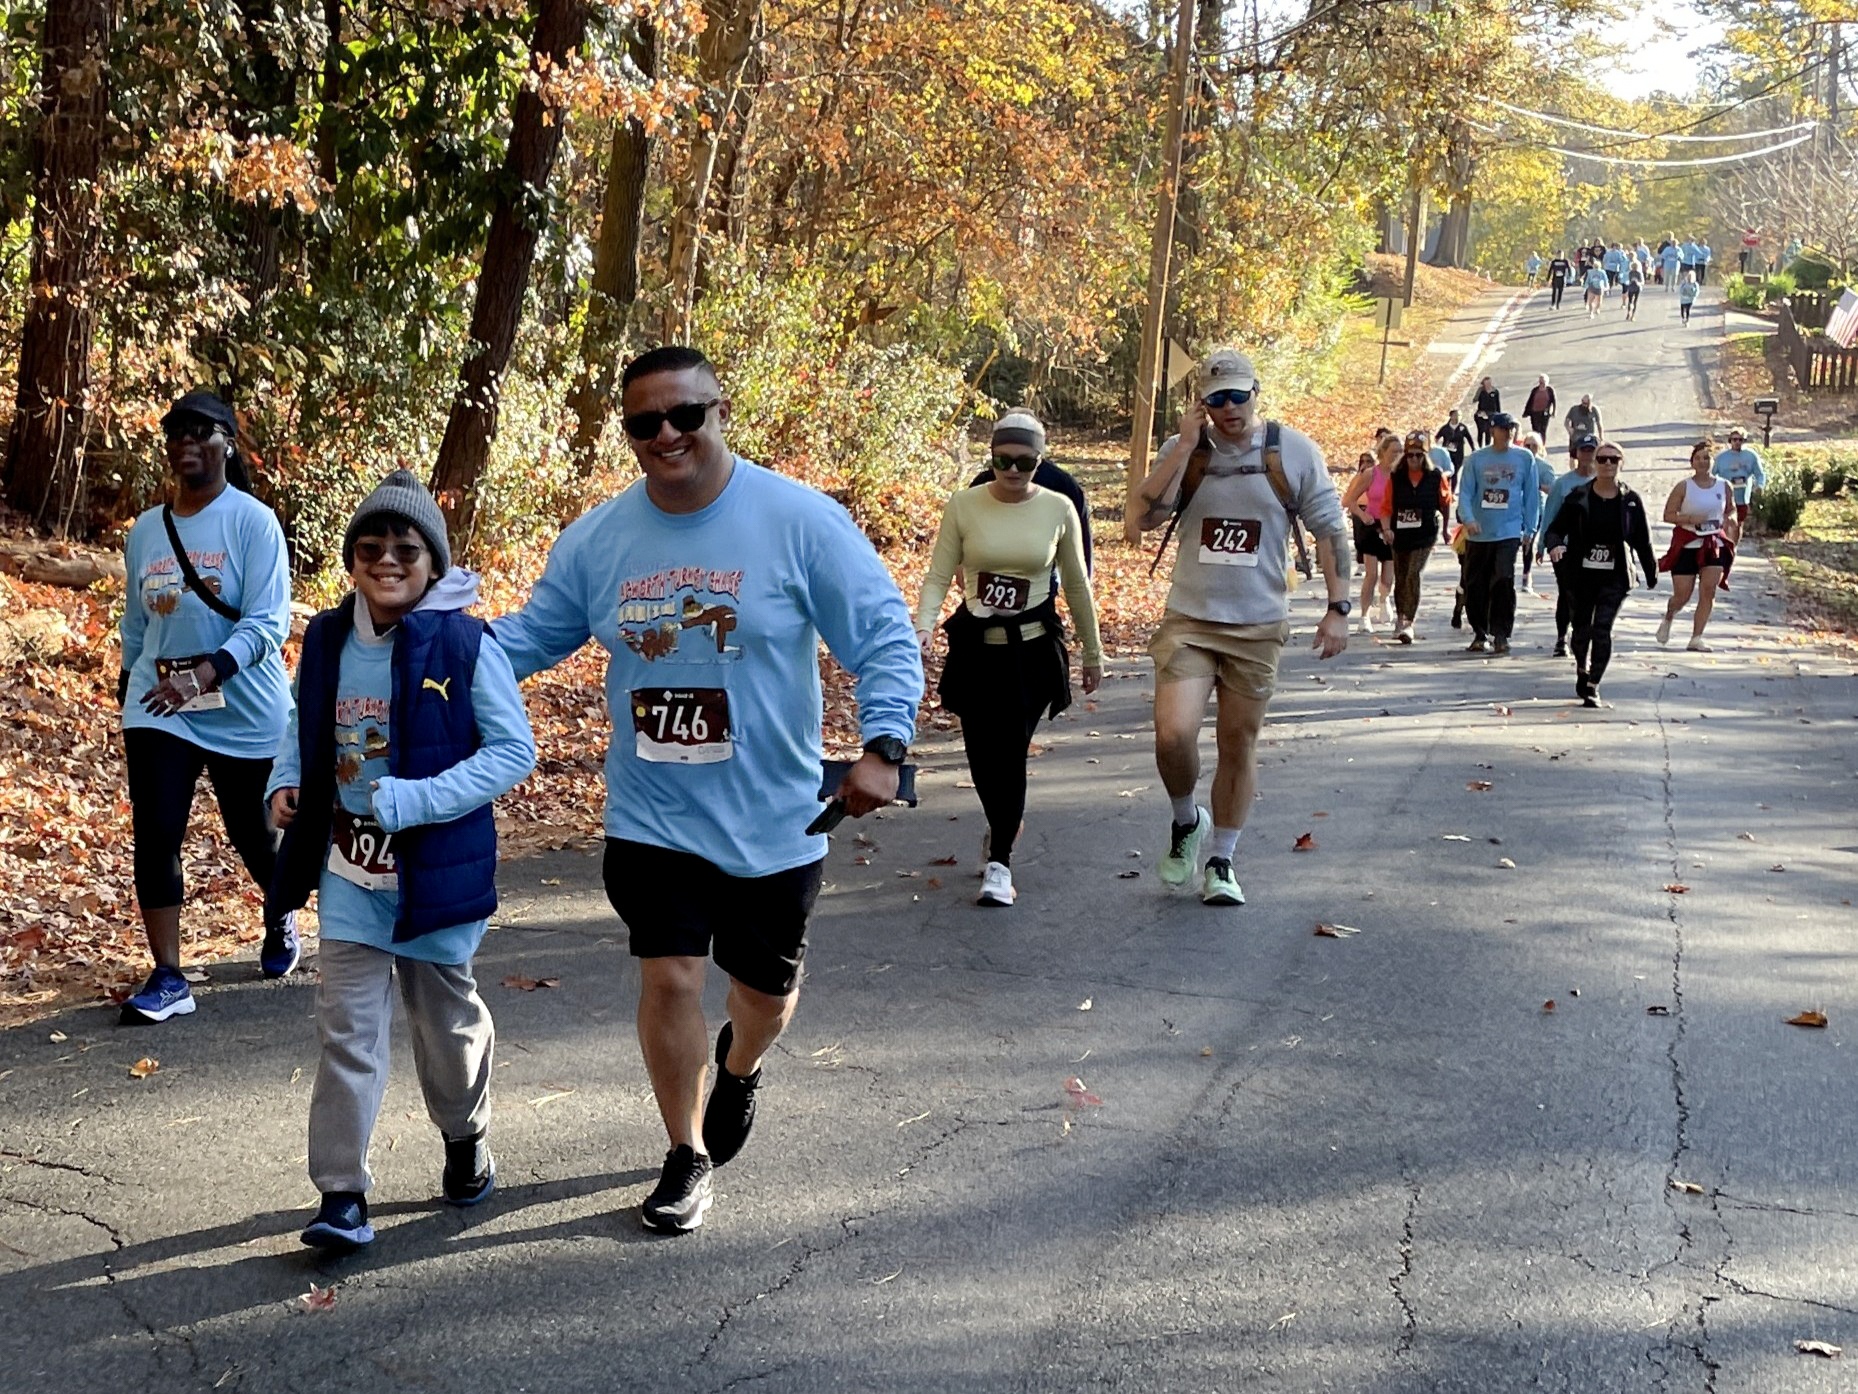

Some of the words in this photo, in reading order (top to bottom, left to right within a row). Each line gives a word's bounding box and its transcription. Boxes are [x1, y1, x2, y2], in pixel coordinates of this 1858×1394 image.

[1212, 528, 1248, 552] 242
[1590, 548, 1610, 562] 209
[983, 583, 1017, 608] 293
[652, 705, 708, 740] 746
